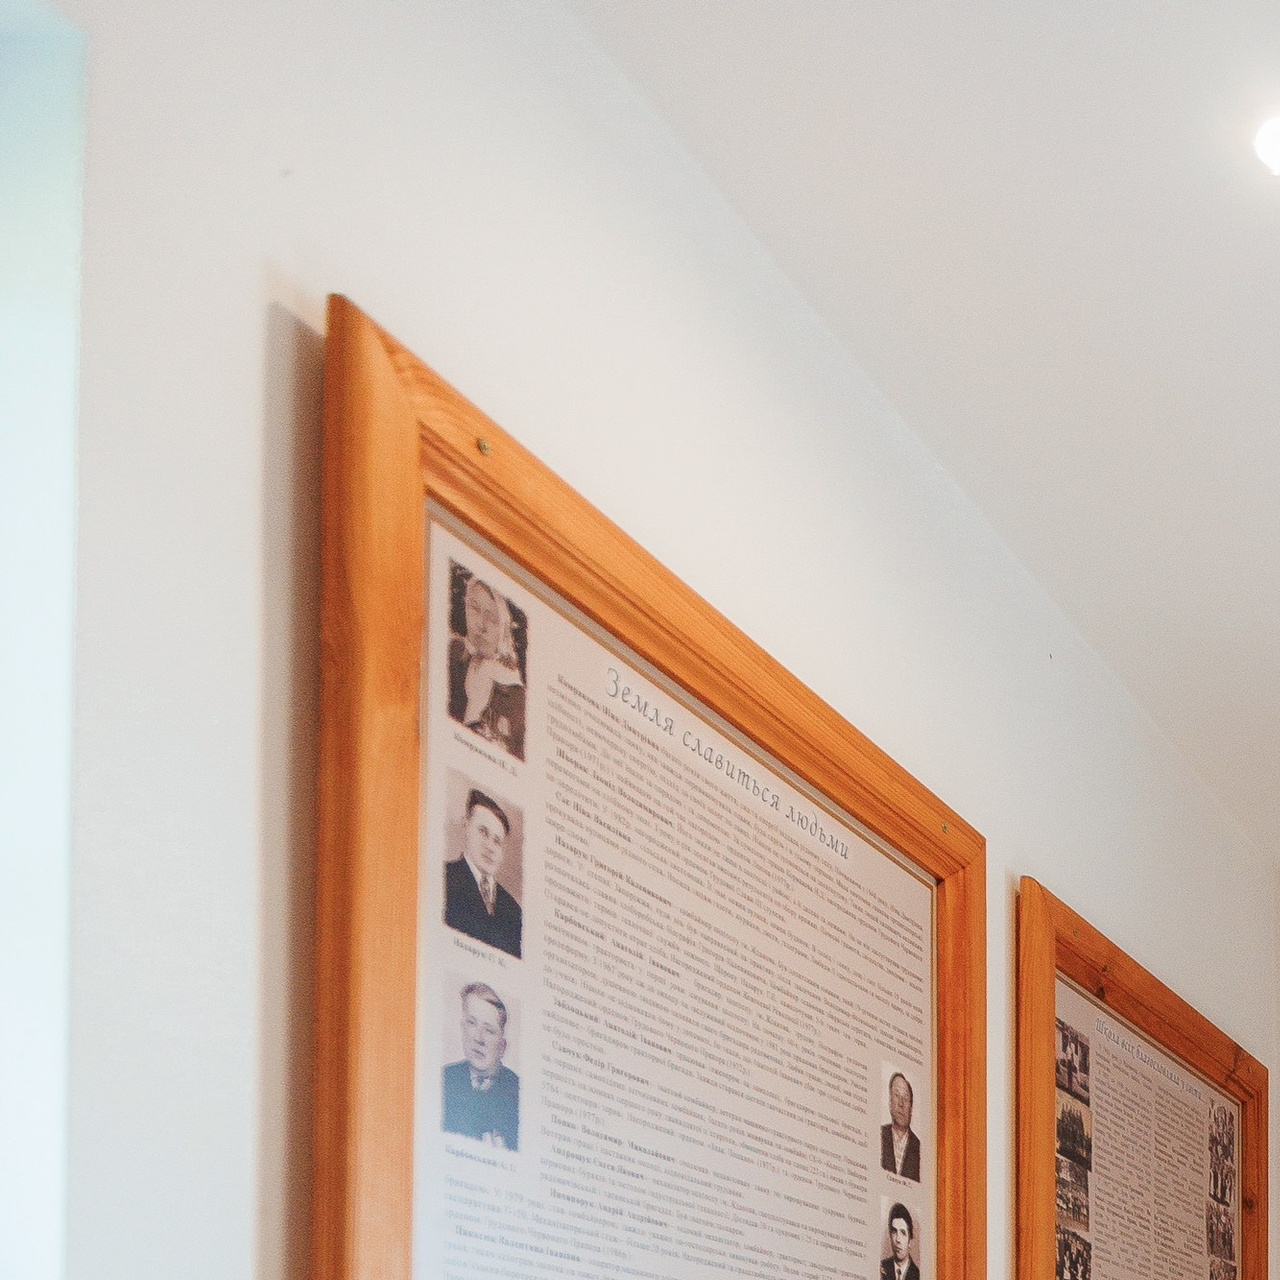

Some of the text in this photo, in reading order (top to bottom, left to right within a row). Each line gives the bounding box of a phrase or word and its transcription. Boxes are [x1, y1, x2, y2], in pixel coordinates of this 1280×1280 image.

[605, 666, 850, 862] Земля славиться людьми
